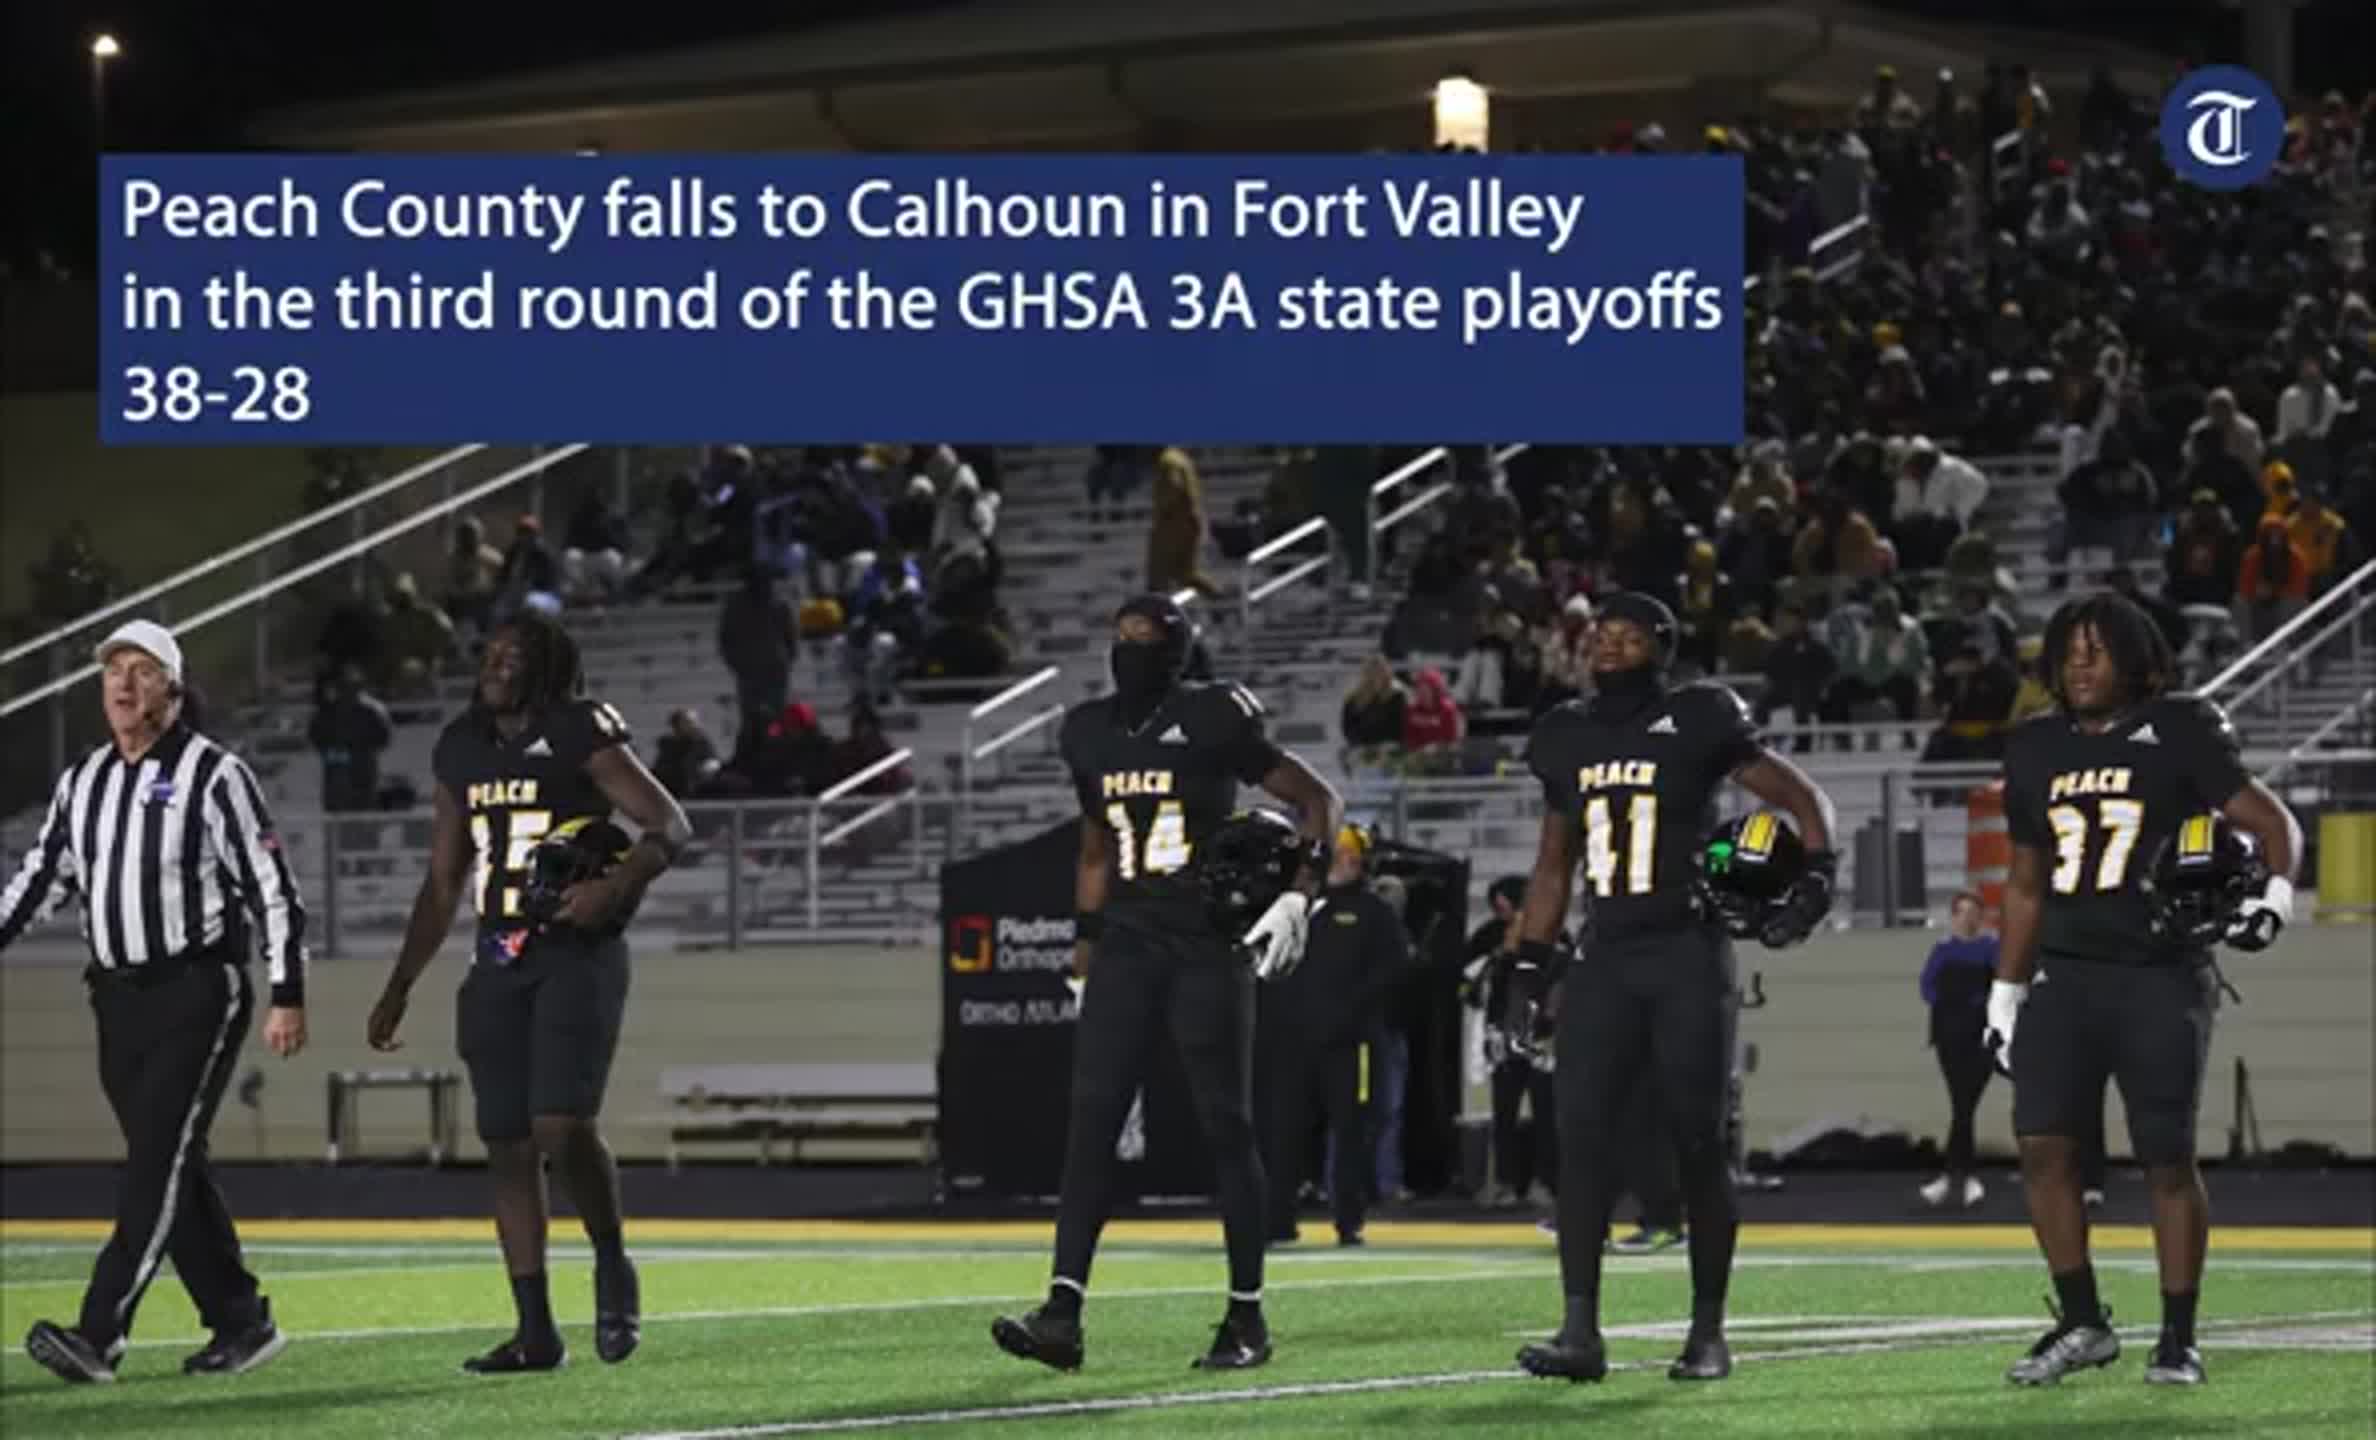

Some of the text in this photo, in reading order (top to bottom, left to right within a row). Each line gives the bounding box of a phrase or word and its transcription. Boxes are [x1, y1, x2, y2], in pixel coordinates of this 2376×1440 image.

[468, 778, 538, 808] PEACH
[1103, 770, 1173, 797] PEACH
[1578, 761, 1657, 792] PEACH
[2049, 766, 2132, 801] PEACH
[1106, 799, 1192, 880] 14
[1585, 793, 1657, 897] 41
[2047, 799, 2143, 894] 37
